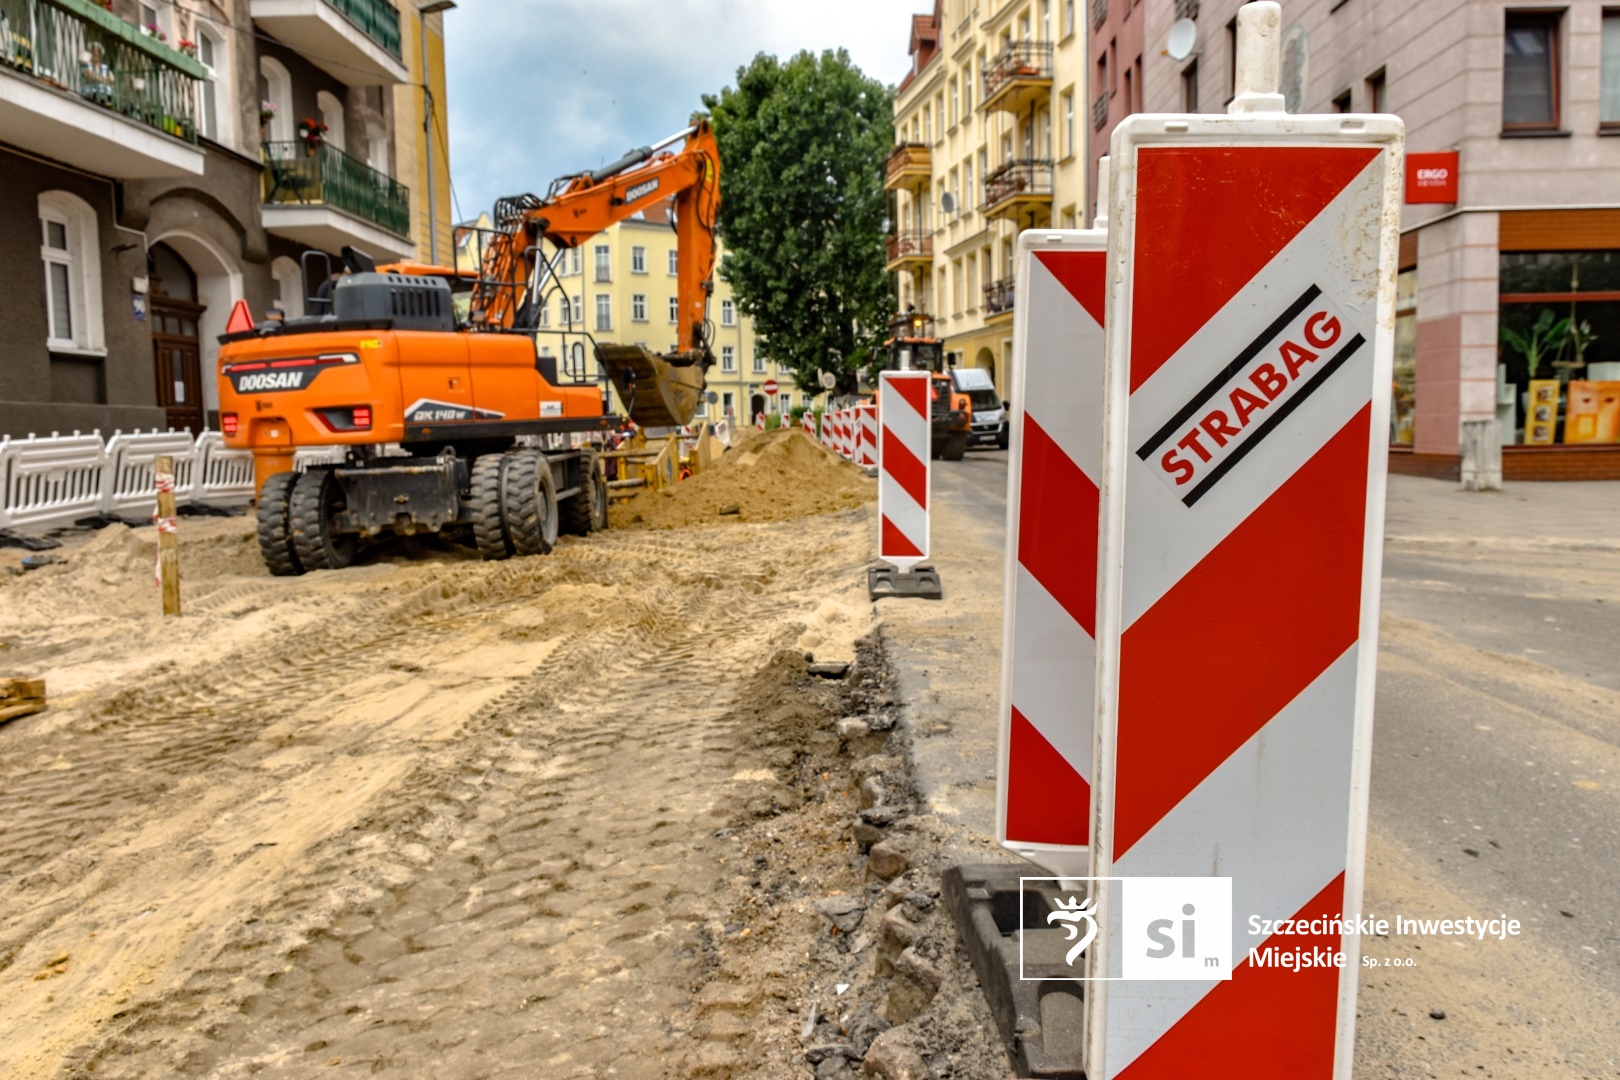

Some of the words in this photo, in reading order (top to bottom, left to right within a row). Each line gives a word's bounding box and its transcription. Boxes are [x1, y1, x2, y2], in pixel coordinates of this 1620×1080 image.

[1417, 168, 1449, 180] ERGO
[239, 371, 303, 392] DOOSAN
[1161, 311, 1342, 486] STRABAG
